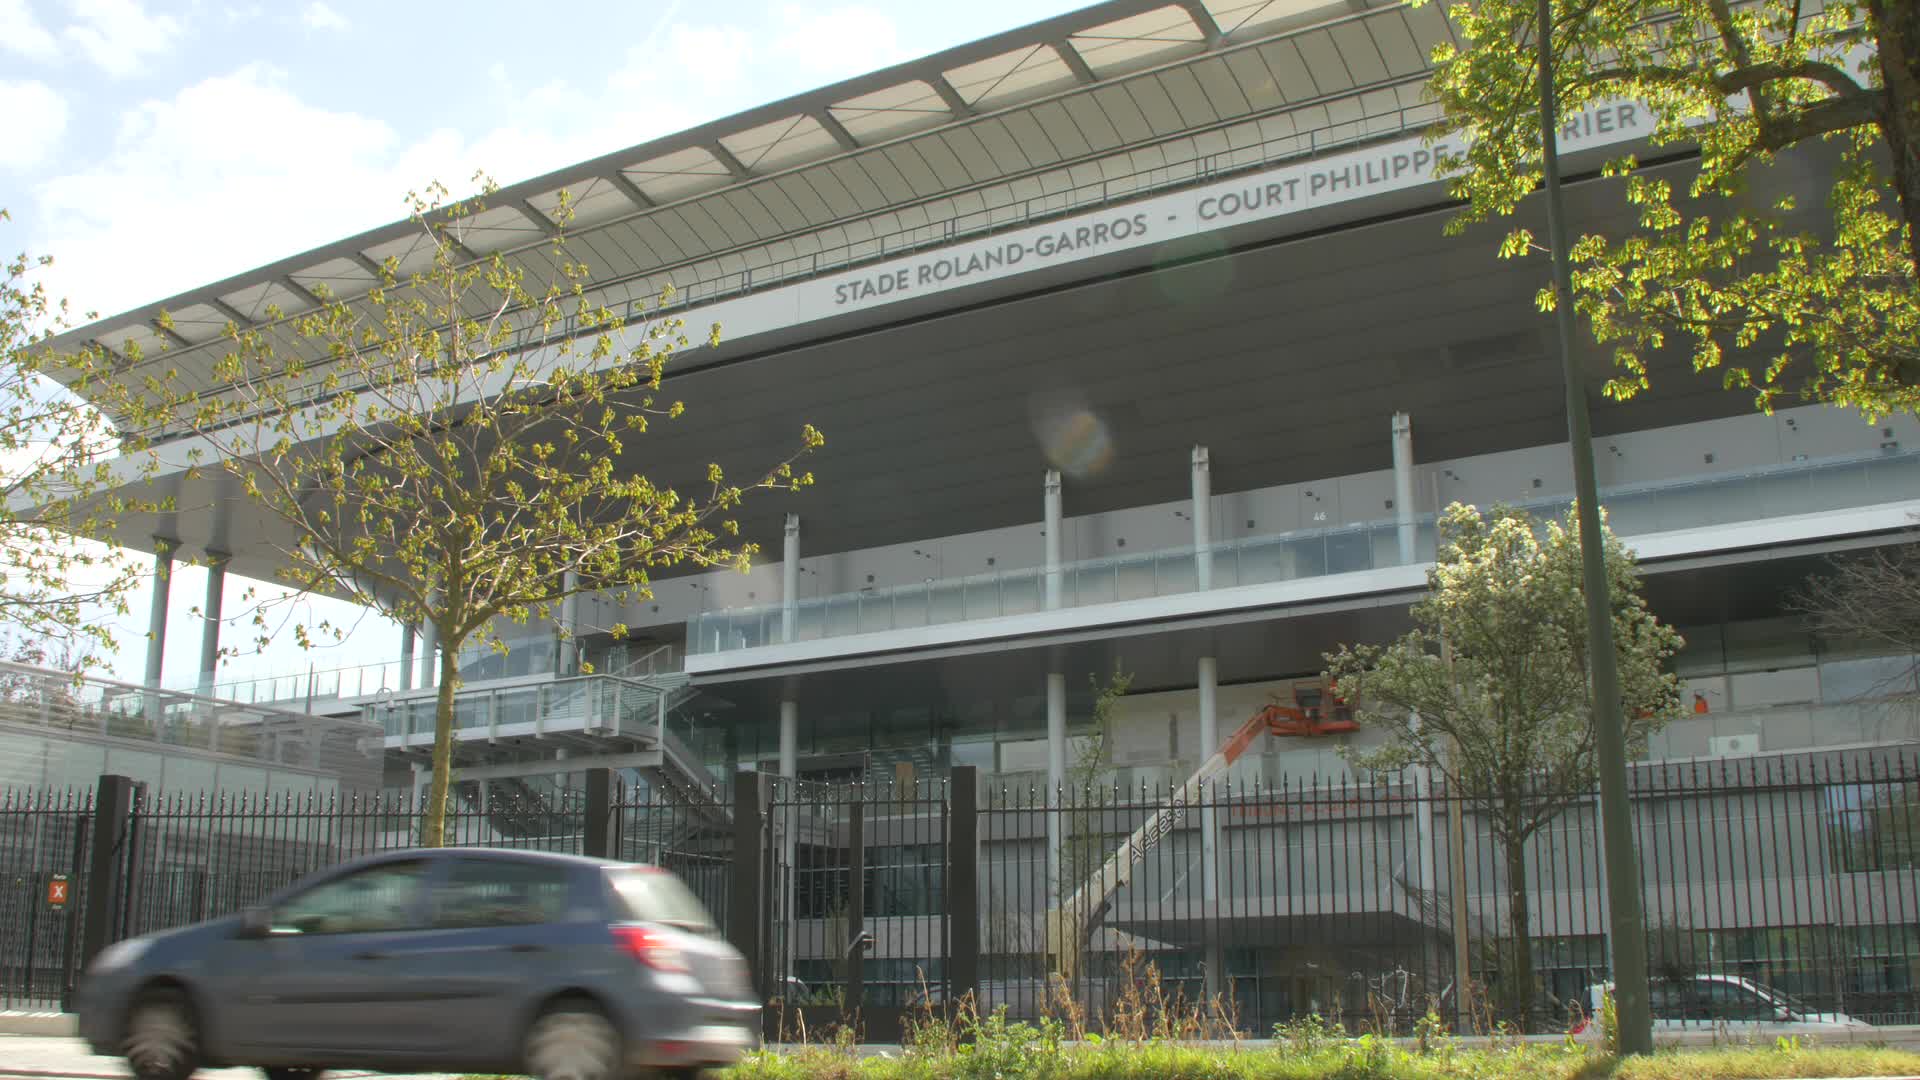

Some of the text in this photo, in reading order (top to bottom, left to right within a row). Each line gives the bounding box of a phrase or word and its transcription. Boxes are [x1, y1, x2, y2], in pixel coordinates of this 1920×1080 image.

[835, 268, 909, 306] STADE
[917, 213, 1147, 285] ROLAND-GARROS
[1198, 178, 1300, 221] COURT
